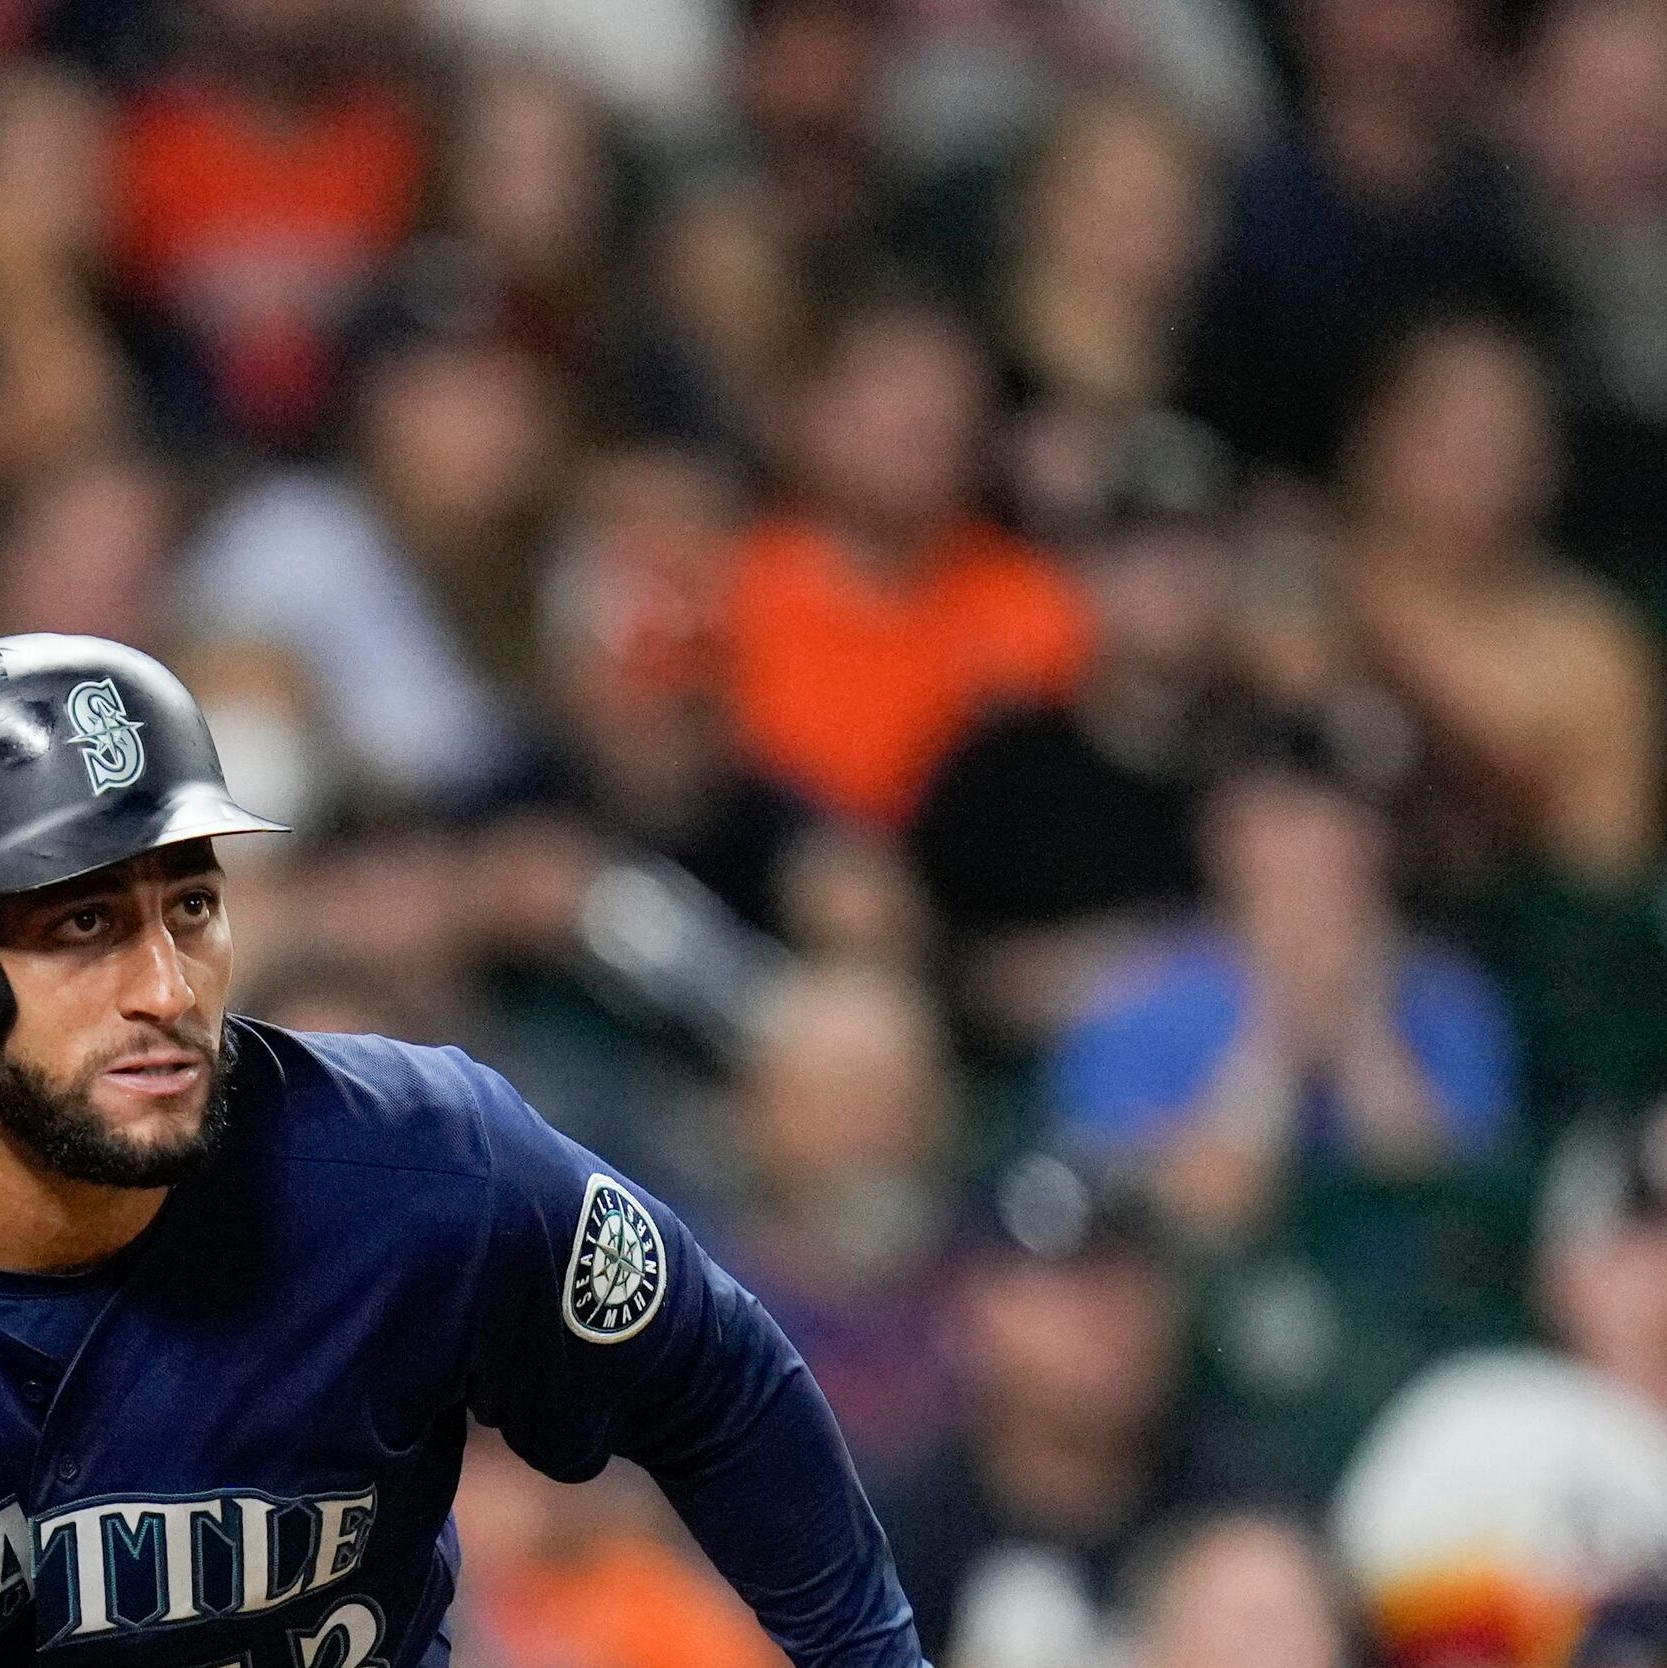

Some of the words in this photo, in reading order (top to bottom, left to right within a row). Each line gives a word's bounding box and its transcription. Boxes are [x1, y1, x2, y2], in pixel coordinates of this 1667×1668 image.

[67, 678, 144, 795] S
[575, 1189, 615, 1309] SEATTLE
[602, 1203, 658, 1329] MARINERS
